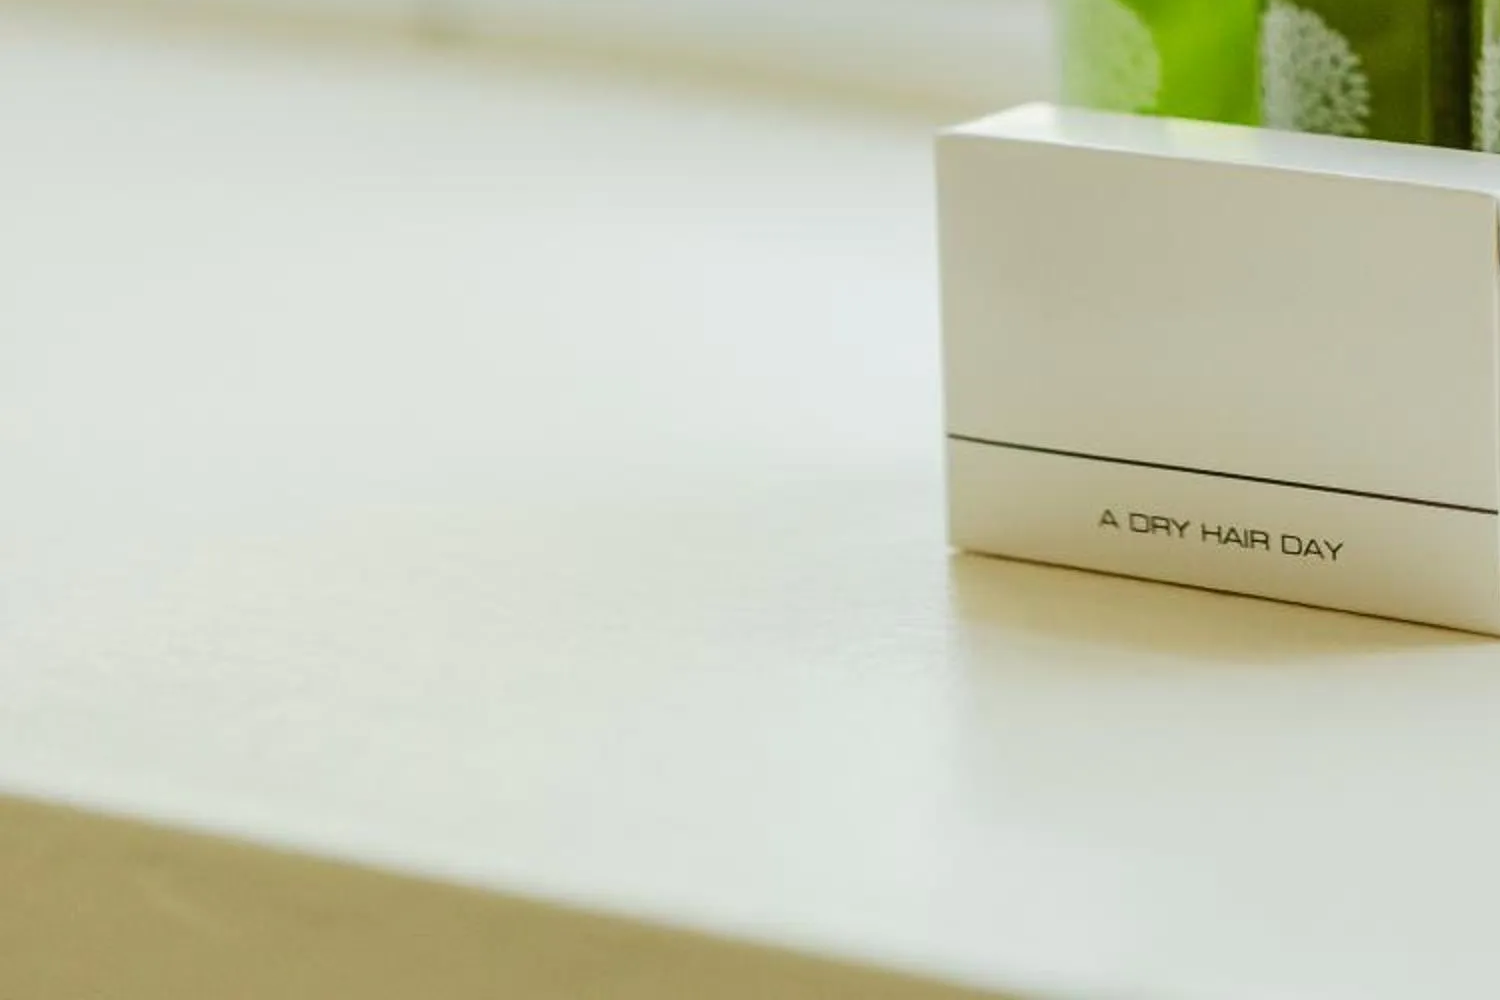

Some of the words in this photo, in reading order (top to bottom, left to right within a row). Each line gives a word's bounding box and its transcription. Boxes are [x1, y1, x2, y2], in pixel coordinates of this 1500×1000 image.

[1100, 508, 1119, 528] A
[1129, 513, 1190, 538] DRY
[1201, 524, 1270, 550] HAIR
[1281, 534, 1344, 561] DAY
